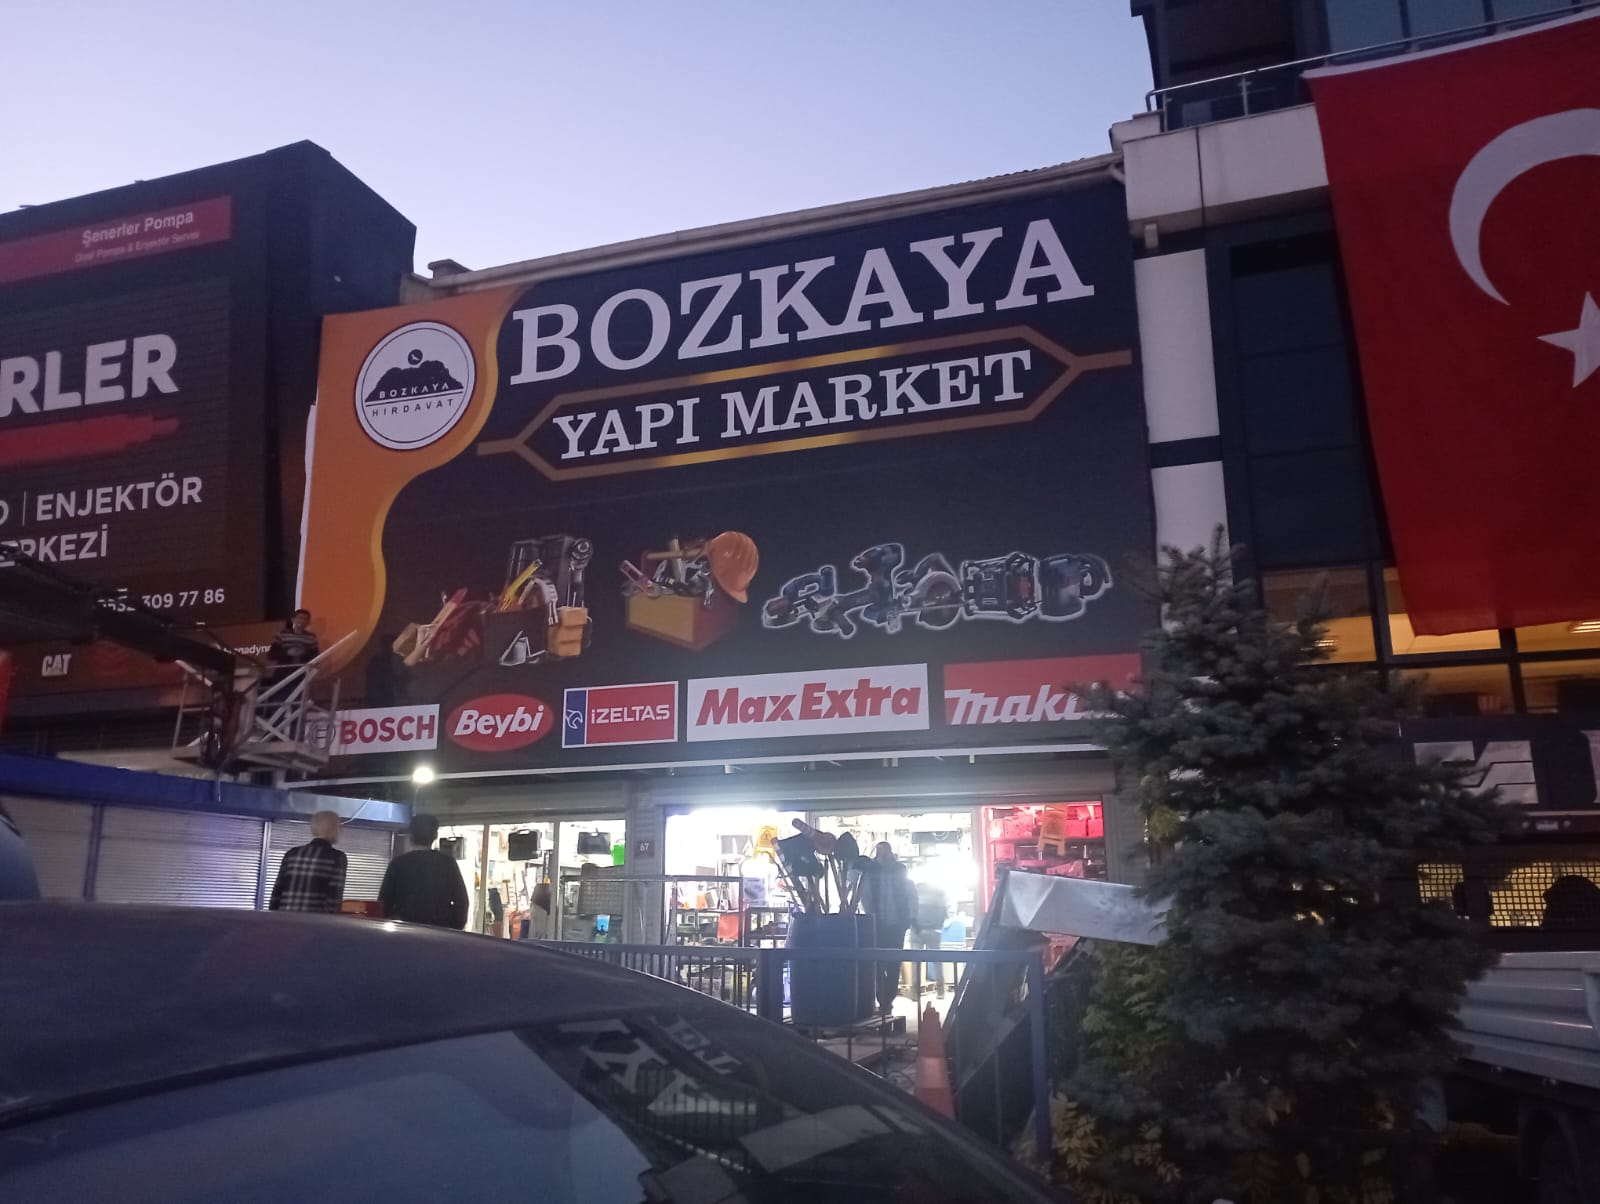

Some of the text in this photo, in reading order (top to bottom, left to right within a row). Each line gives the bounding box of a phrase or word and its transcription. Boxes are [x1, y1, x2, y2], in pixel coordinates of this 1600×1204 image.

[82, 211, 194, 248] Şenerler Pompa
[509, 218, 1095, 386] BOZKAYA
[379, 382, 449, 399] BOZKAYA
[553, 349, 1032, 461] YAPI MARKET
[372, 398, 454, 417] HIRDAVAT
[36, 472, 203, 522] ENJEKTÖR
[178, 591, 200, 608] 77
[203, 588, 225, 605] 86
[41, 653, 72, 677] CAT
[339, 714, 436, 745] BOSCH
[453, 704, 544, 738] Beybi
[639, 842, 650, 852] 67
